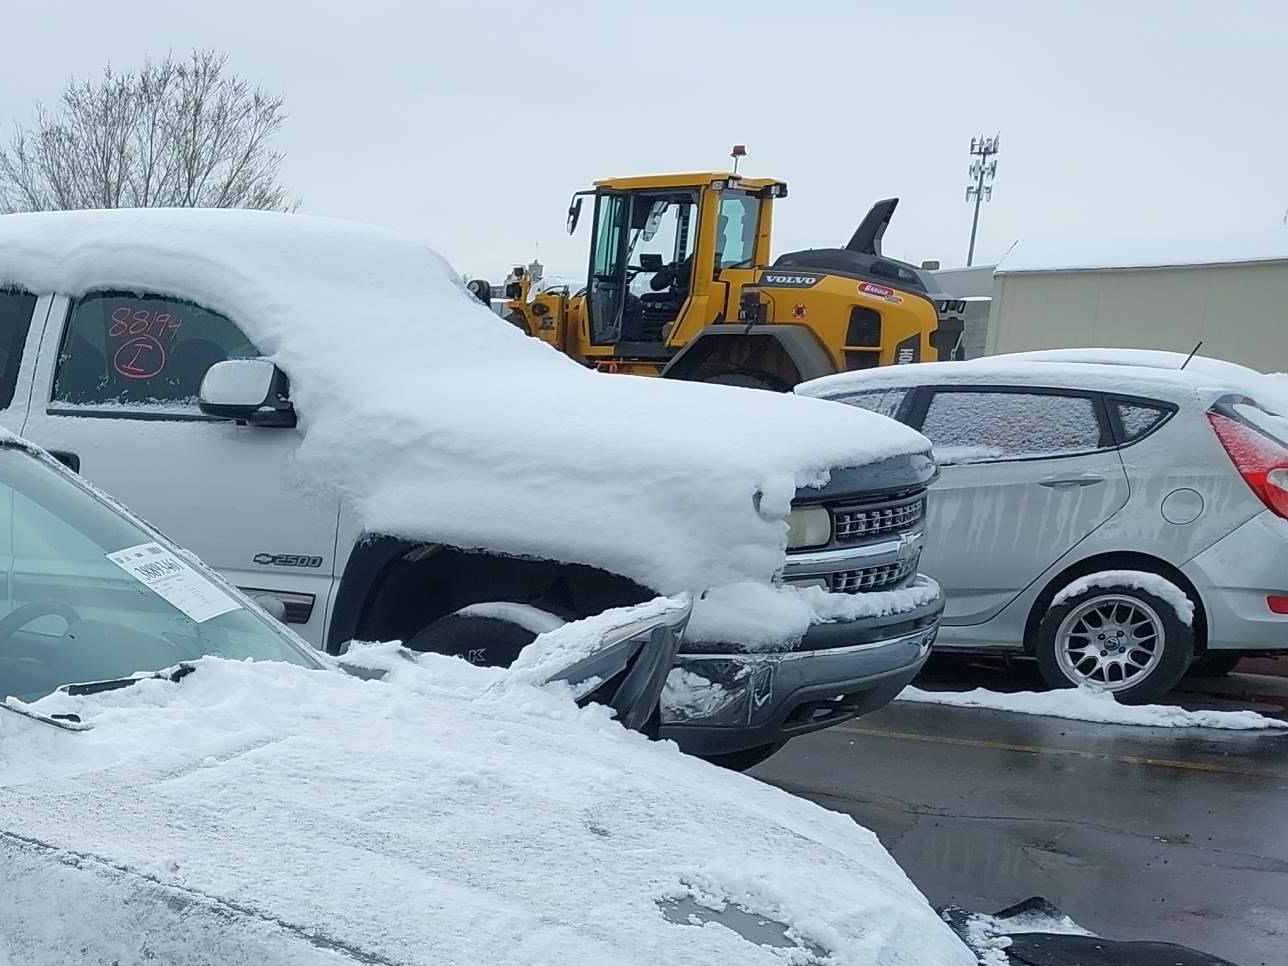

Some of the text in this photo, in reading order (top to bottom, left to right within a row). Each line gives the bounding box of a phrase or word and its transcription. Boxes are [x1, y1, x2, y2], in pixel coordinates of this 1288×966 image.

[765, 275, 816, 284] VOLVO
[109, 307, 182, 341] 88194
[273, 554, 323, 568] 2500
